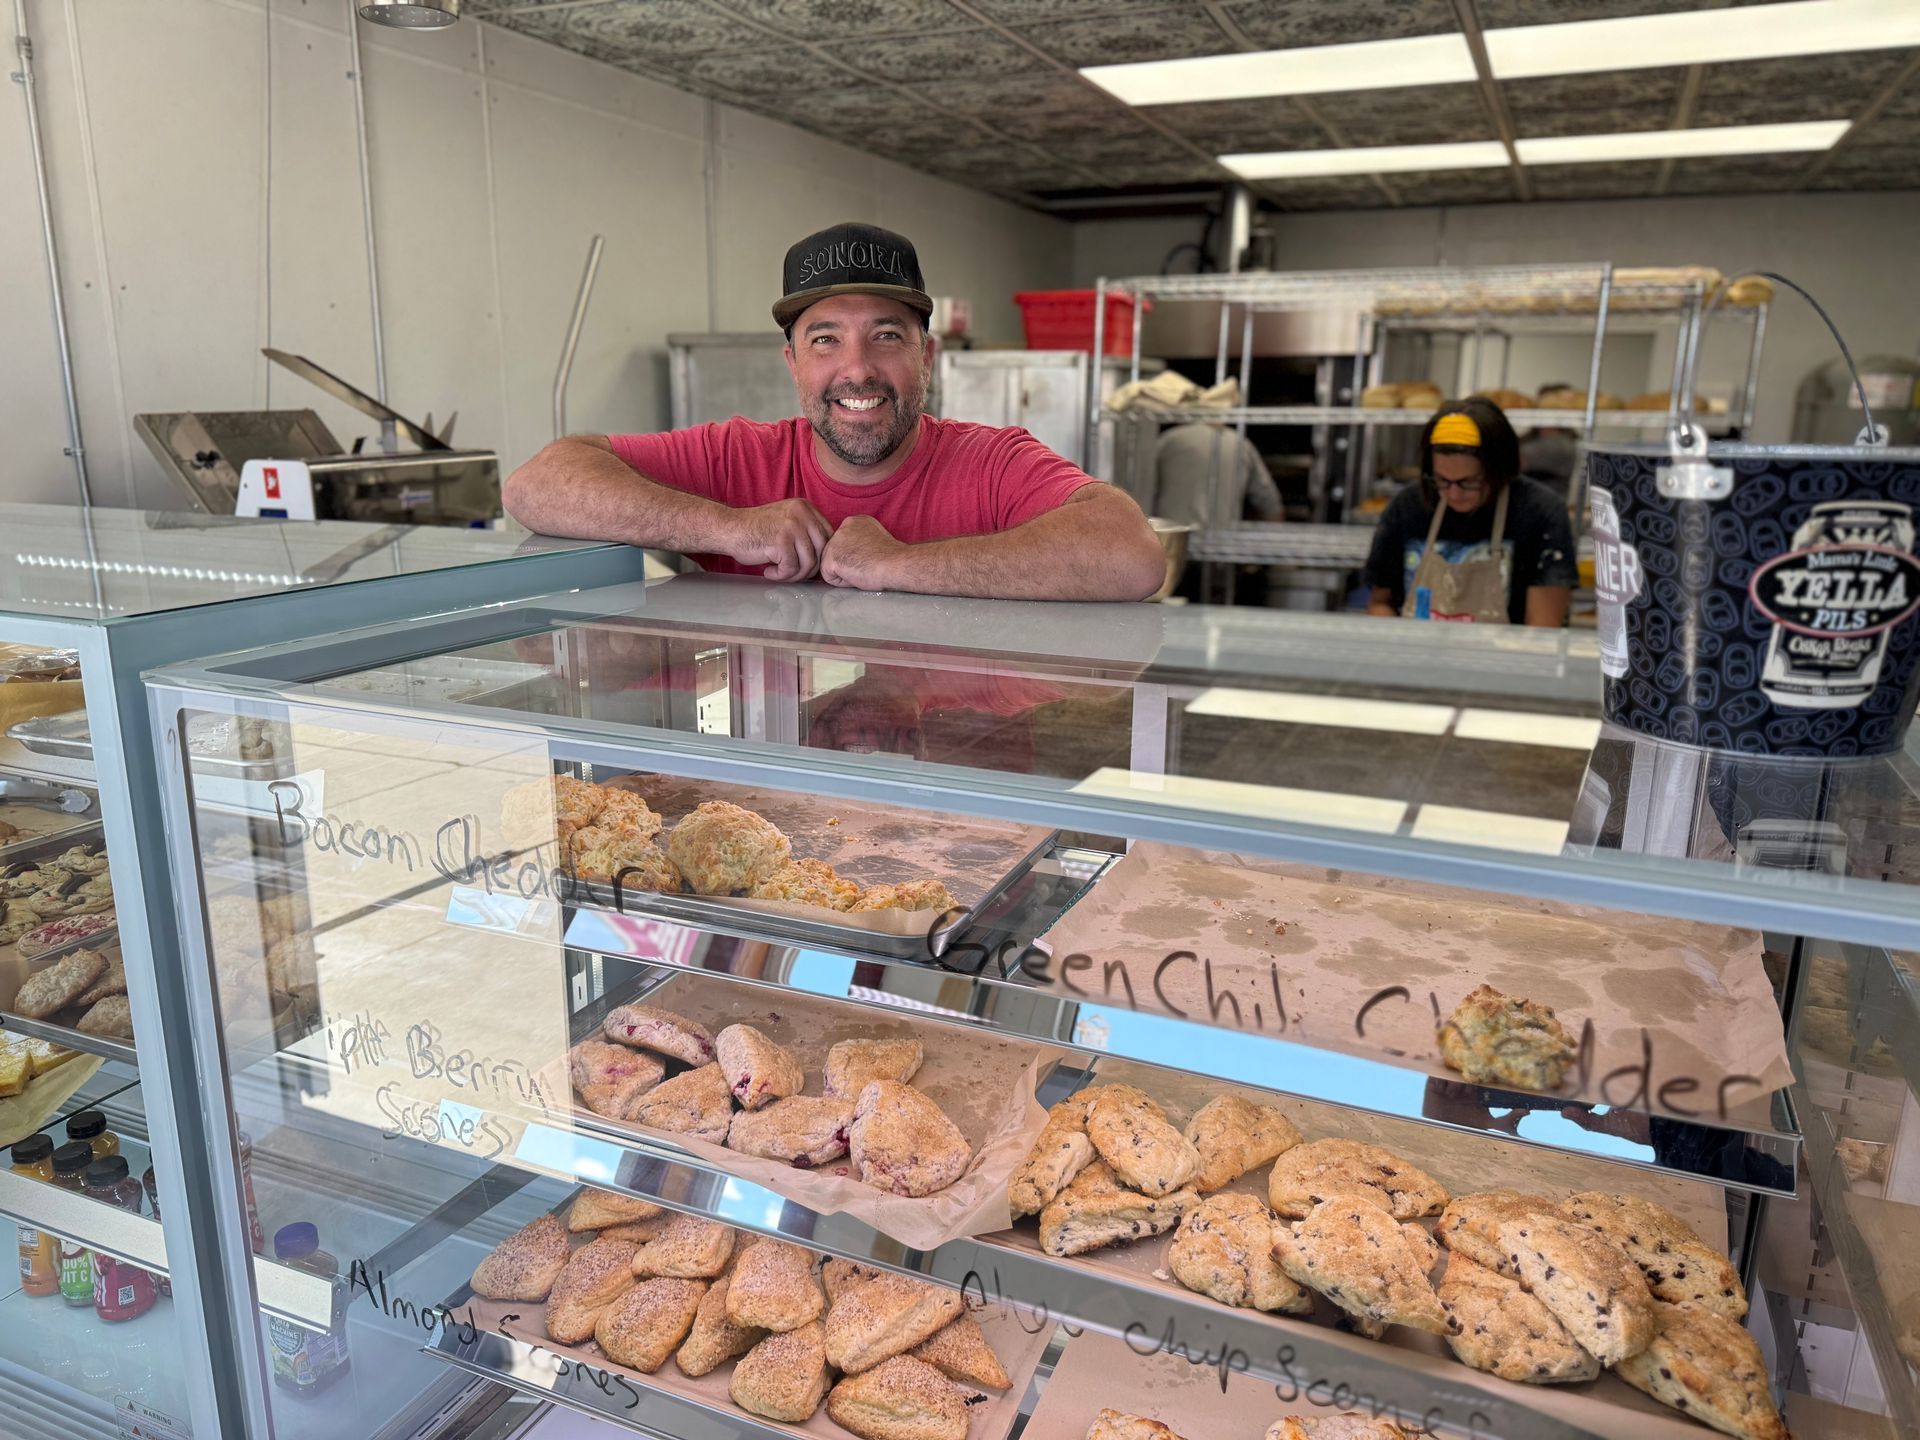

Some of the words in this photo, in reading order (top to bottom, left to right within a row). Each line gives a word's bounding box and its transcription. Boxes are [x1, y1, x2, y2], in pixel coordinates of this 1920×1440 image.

[800, 240, 908, 284] SONORA
[1774, 569, 1908, 609] YELLA
[1811, 609, 1868, 630] PILS
[267, 780, 414, 872] Bacon
[927, 904, 1137, 1014] Green
[350, 1259, 478, 1345] Almond
